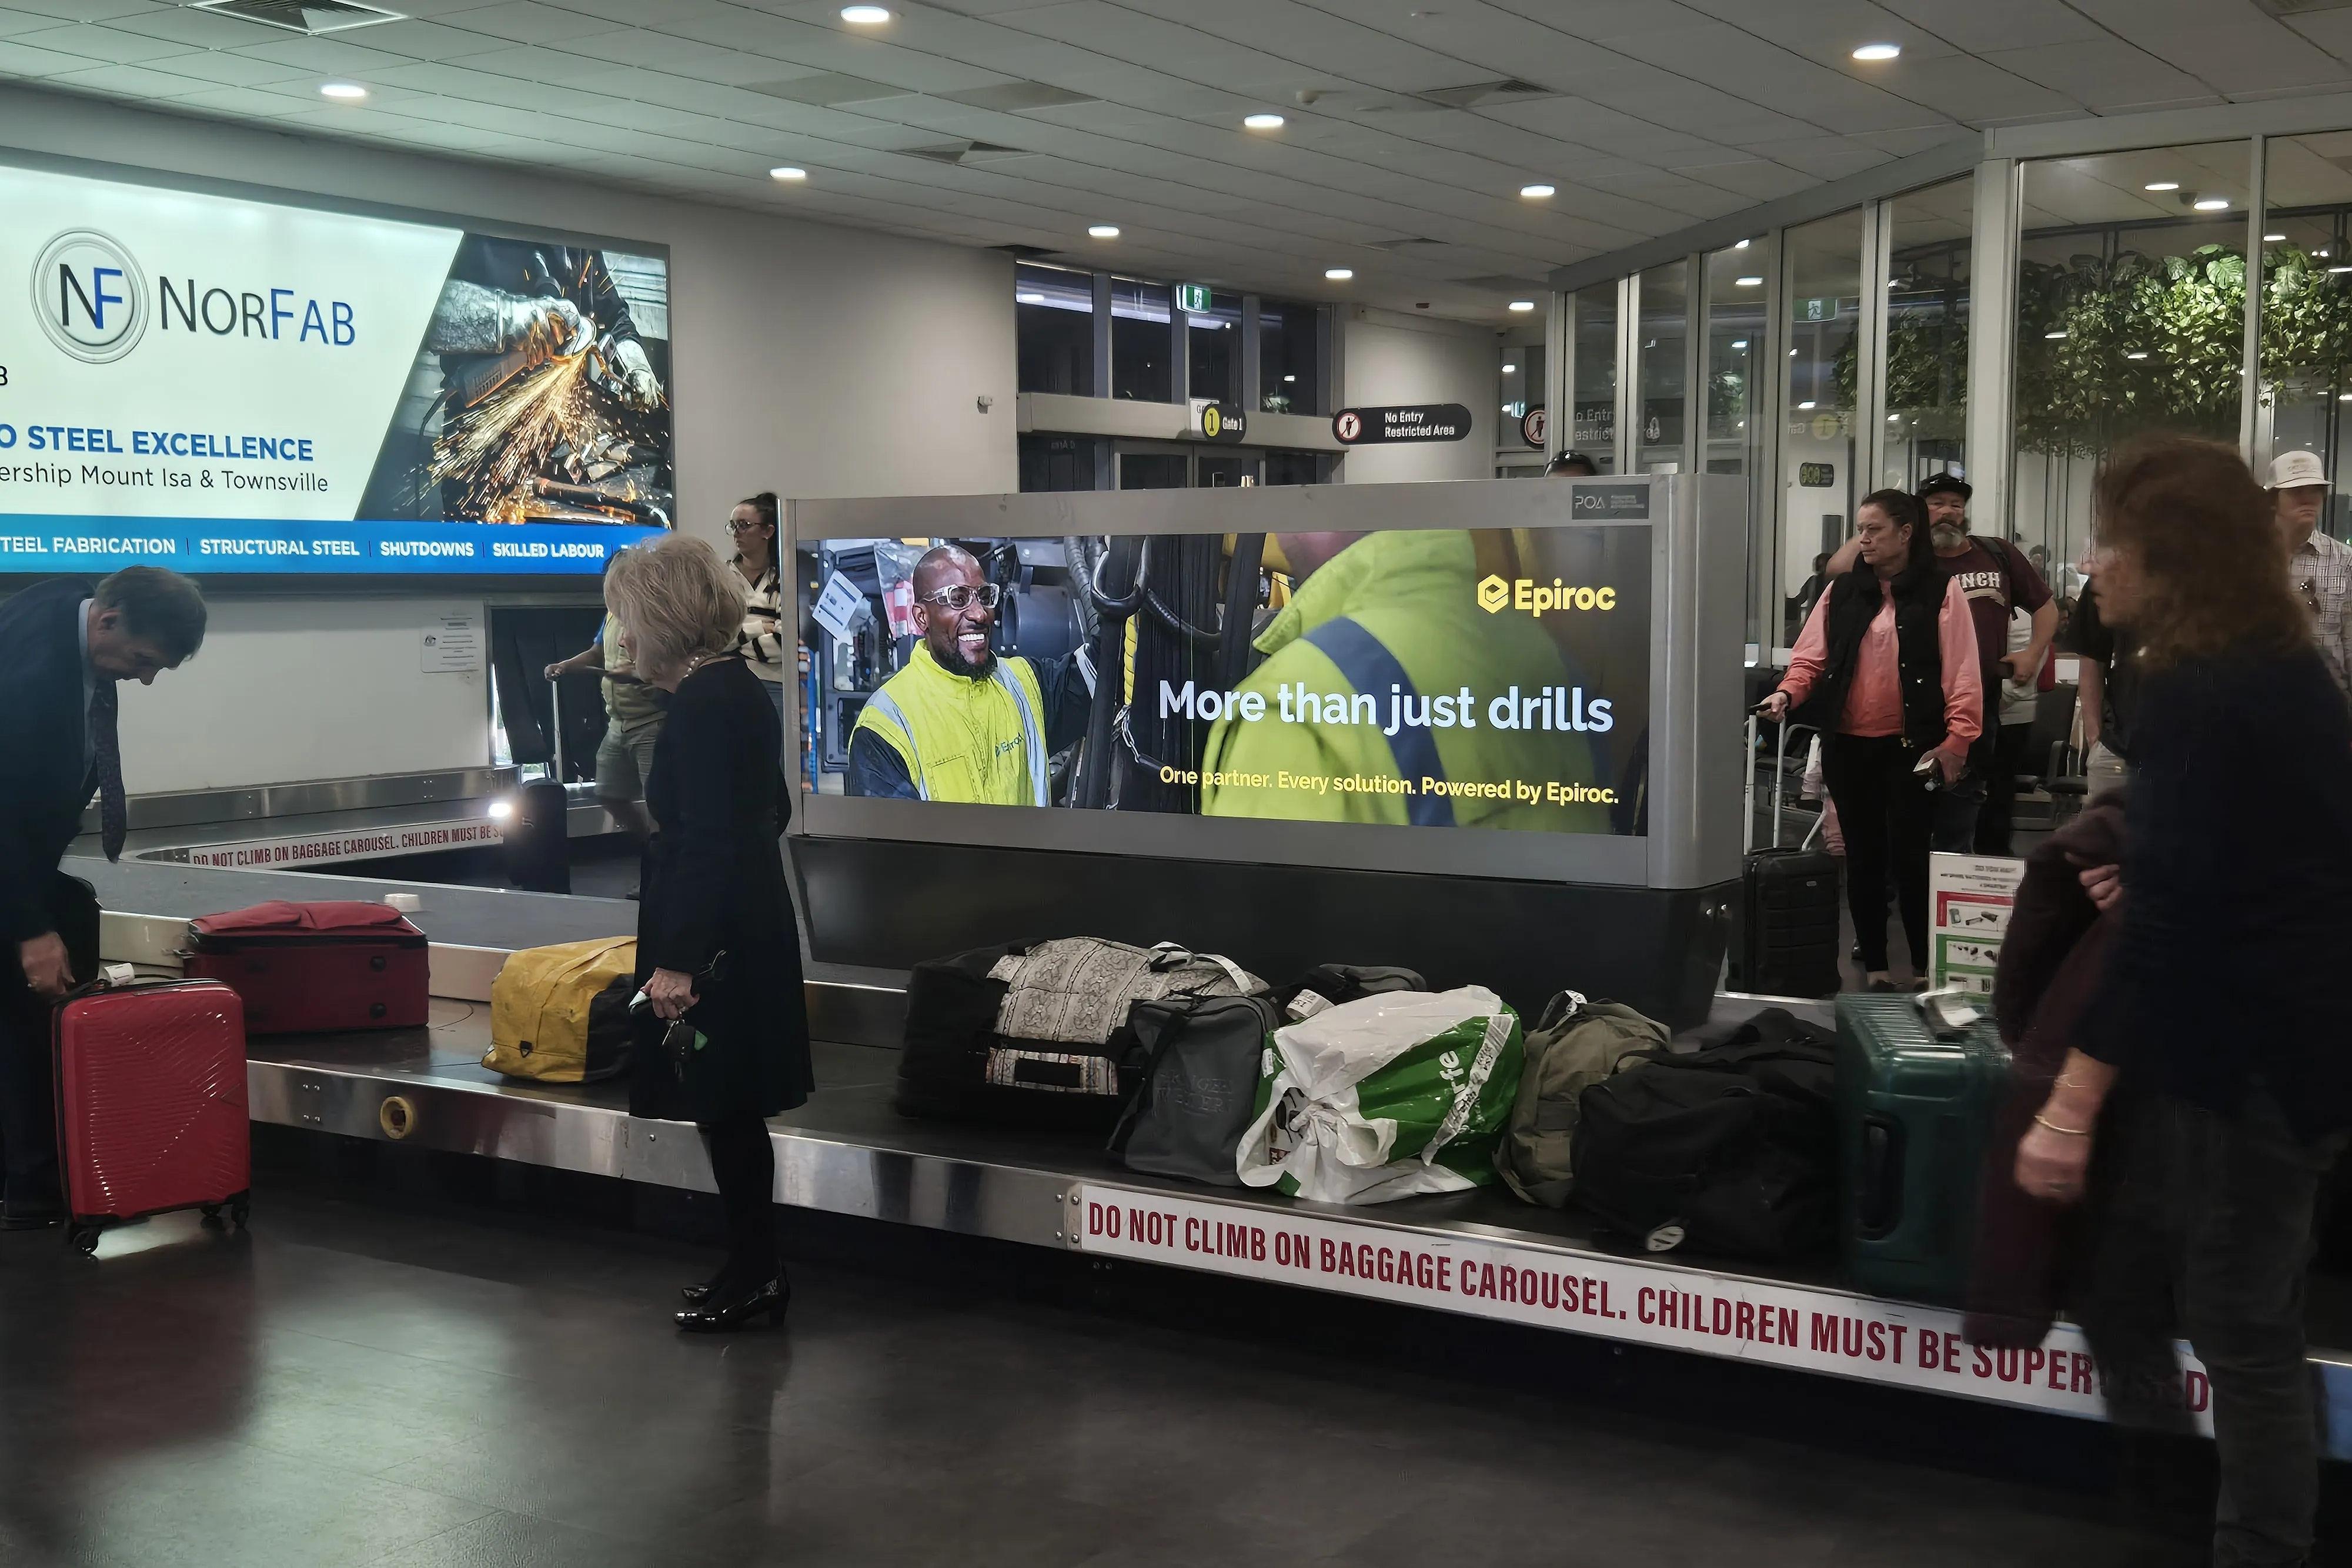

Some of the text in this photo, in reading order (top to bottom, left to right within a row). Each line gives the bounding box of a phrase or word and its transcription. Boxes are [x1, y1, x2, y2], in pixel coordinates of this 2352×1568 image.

[59, 263, 122, 329] NF
[1222, 416, 1238, 430] Gate
[1385, 410, 1424, 424] No Entry
[1385, 424, 1455, 438] Restricted Area
[28, 425, 123, 453] STEEL
[133, 430, 314, 462] EXCELLENCE
[82, 464, 154, 487] Mount
[163, 468, 192, 488] Isa
[200, 469, 215, 489] &
[222, 470, 329, 492] Townsville
[52, 536, 176, 554] FABRICATION
[200, 539, 360, 556] STRUCTURAL STEEL
[380, 541, 475, 557] SHUTDOWNS
[493, 542, 549, 557] SKILLED
[551, 543, 604, 558] LABOUR
[1514, 578, 1616, 618] Epiroc
[1159, 680, 1613, 737] More than just drills
[1160, 765, 1619, 807] One partner. Every solution. Powered by Epiroc.
[212, 852, 233, 866] NOT
[237, 848, 270, 865] CLIMB
[275, 847, 289, 861] ON
[293, 841, 341, 860] BAGGAGE
[343, 835, 399, 854] CAROUSEL.
[402, 830, 449, 847] CHILDREN
[452, 827, 477, 842] MUST
[480, 825, 492, 839] BE
[1088, 1202, 1121, 1238] DO
[1129, 1208, 1178, 1247] NOT
[1185, 1216, 1265, 1261] CLIMB
[1275, 1231, 1311, 1269] ON
[1320, 1238, 1451, 1292] BAGGAGE
[1461, 1260, 1628, 1320] CAROUSEL.
[1636, 1287, 1799, 1348] CHILDREN
[1810, 1313, 1907, 1365] MUST
[1919, 1329, 1961, 1374] BE
